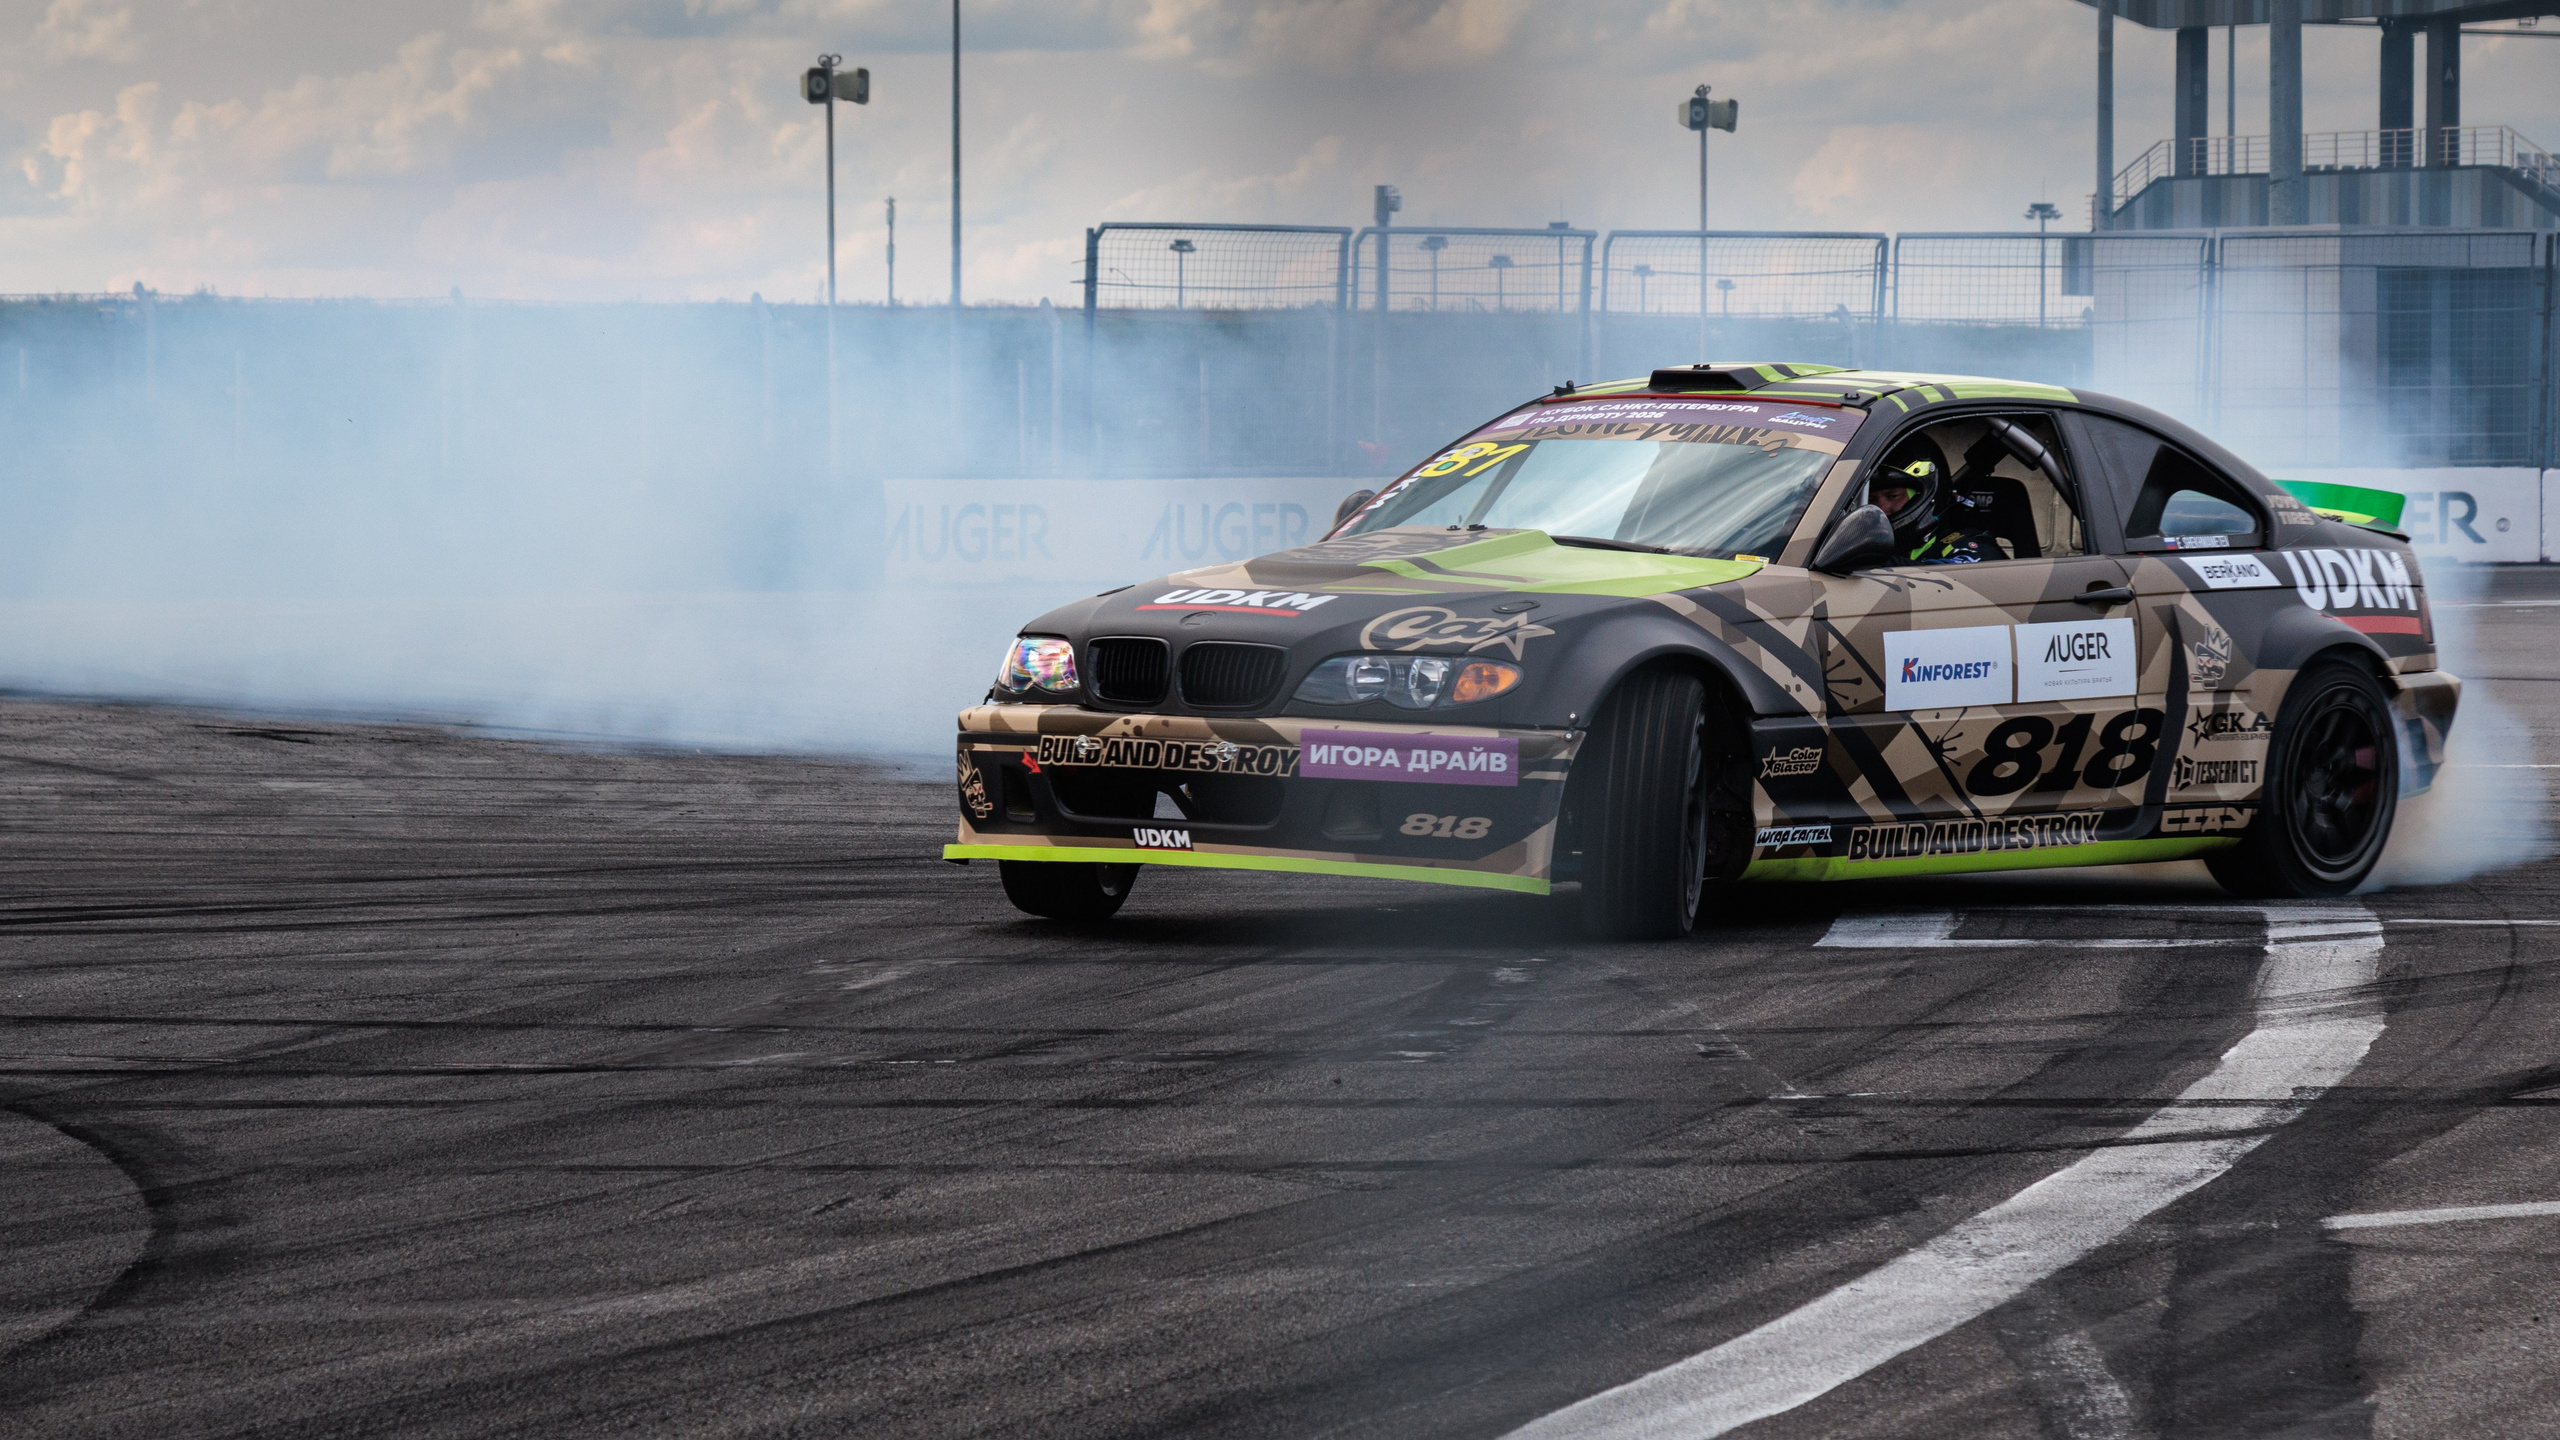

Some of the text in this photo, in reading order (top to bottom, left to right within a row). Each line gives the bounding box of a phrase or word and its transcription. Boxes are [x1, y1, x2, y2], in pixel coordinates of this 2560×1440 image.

[1529, 411, 1667, 425] ПО ДРИФТУ 2026
[1541, 402, 1760, 416] КУБОК САНКТ-ПЕТЕРБУРГА
[886, 502, 1054, 563] AUGER
[1139, 502, 1309, 561] AUGER
[2203, 563, 2260, 580] BERKANO
[2281, 548, 2418, 611] UDKM
[1153, 589, 1339, 610] UDKM
[2044, 632, 2112, 663] AUGER
[1037, 735, 1104, 766] BUILD
[1101, 738, 1162, 769] AND
[1309, 744, 1508, 773] ИГОРА ДРАЙВ
[1790, 748, 1821, 761] Color
[1966, 708, 2165, 796] 818
[1773, 761, 1818, 774] Blaster
[2195, 760, 2258, 785] TESSERACT
[1133, 828, 1191, 848] UDKM
[1400, 813, 1492, 839] 818
[1848, 812, 2104, 862] BUILD AND DESTROY
